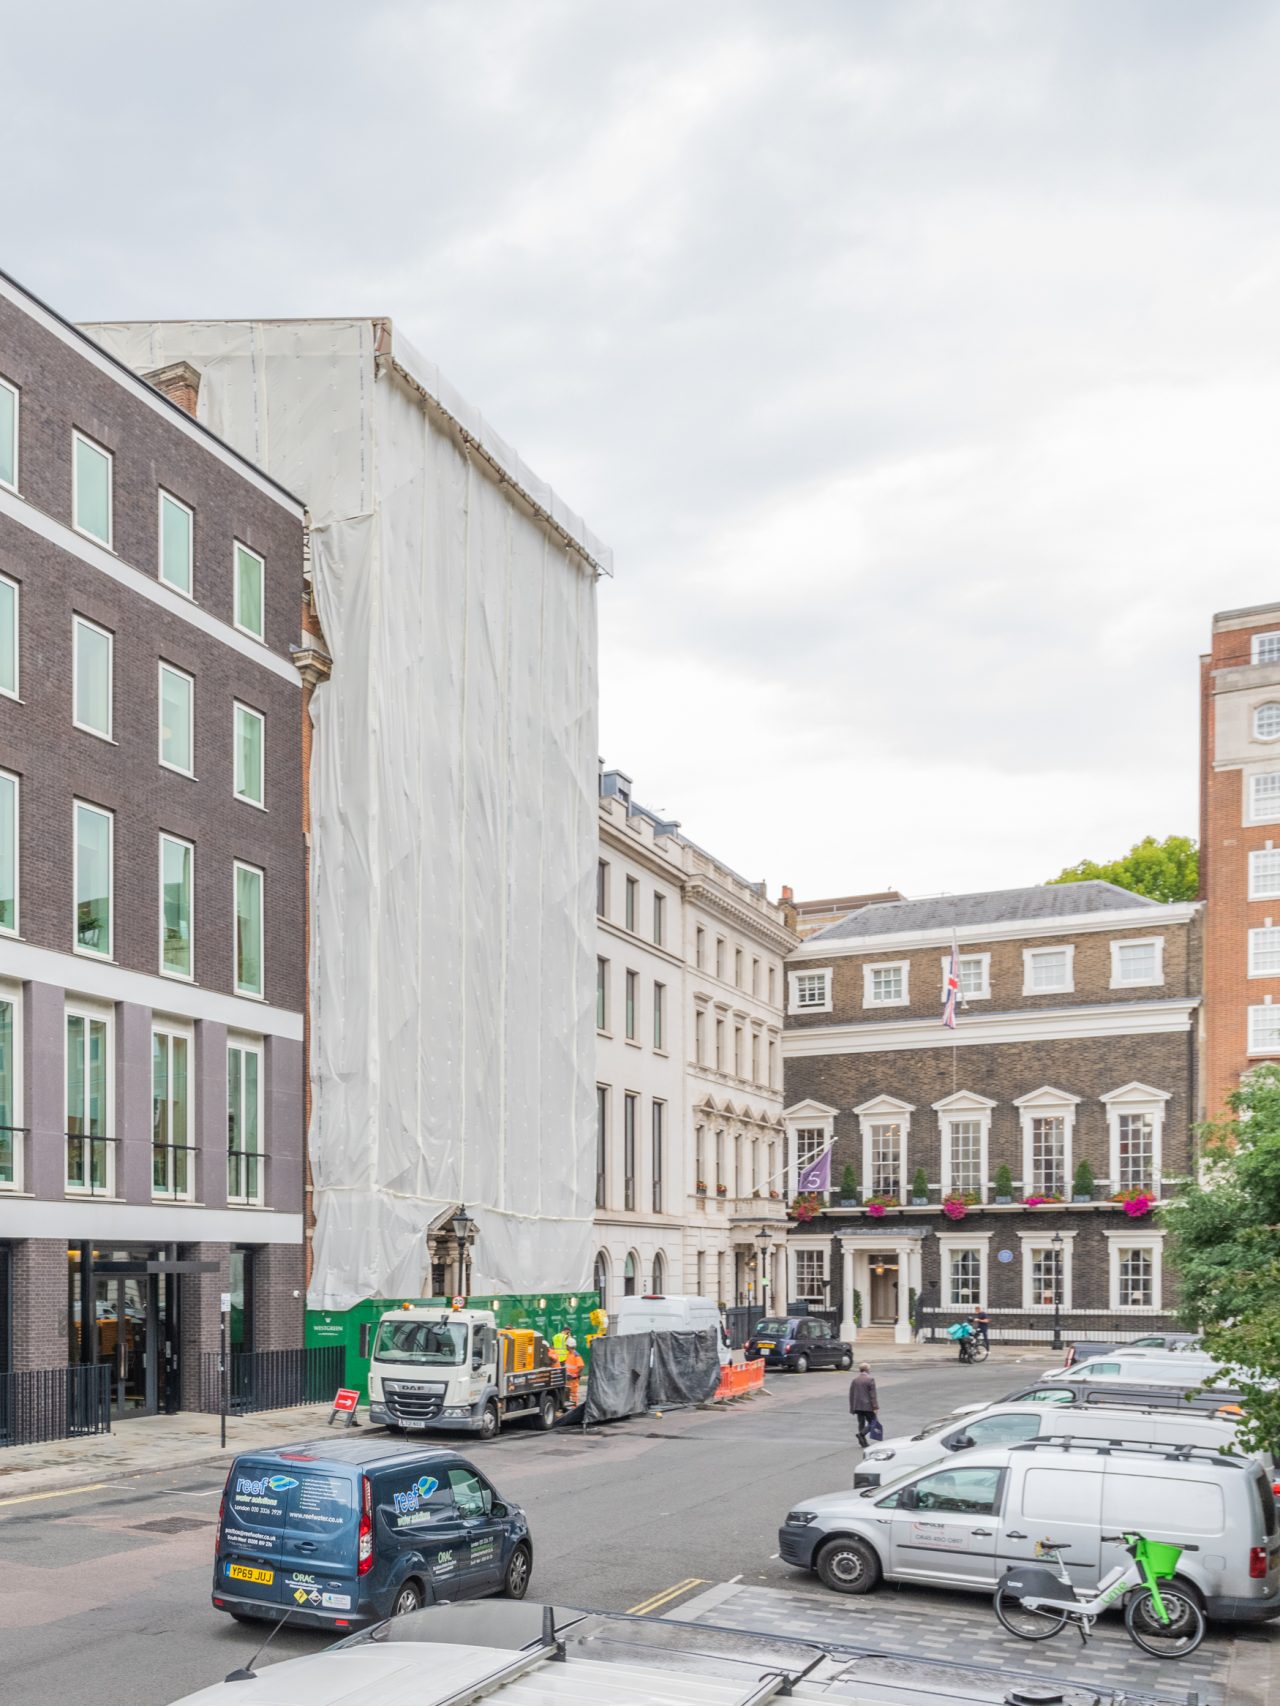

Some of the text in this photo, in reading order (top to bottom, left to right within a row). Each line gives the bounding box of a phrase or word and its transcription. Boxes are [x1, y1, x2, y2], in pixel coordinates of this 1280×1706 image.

[807, 1171, 821, 1188] 5
[236, 1476, 269, 1495] reef
[251, 1495, 278, 1506] solutions
[393, 1483, 420, 1513] reef
[251, 1505, 259, 1513] 020
[289, 1511, 344, 1523] www.reefwater.co.uk
[438, 1550, 453, 1563] ORAC
[232, 1566, 272, 1583] YP69 JUJ
[292, 1572, 315, 1583] ORAC
[1101, 1581, 1128, 1605] Lime
